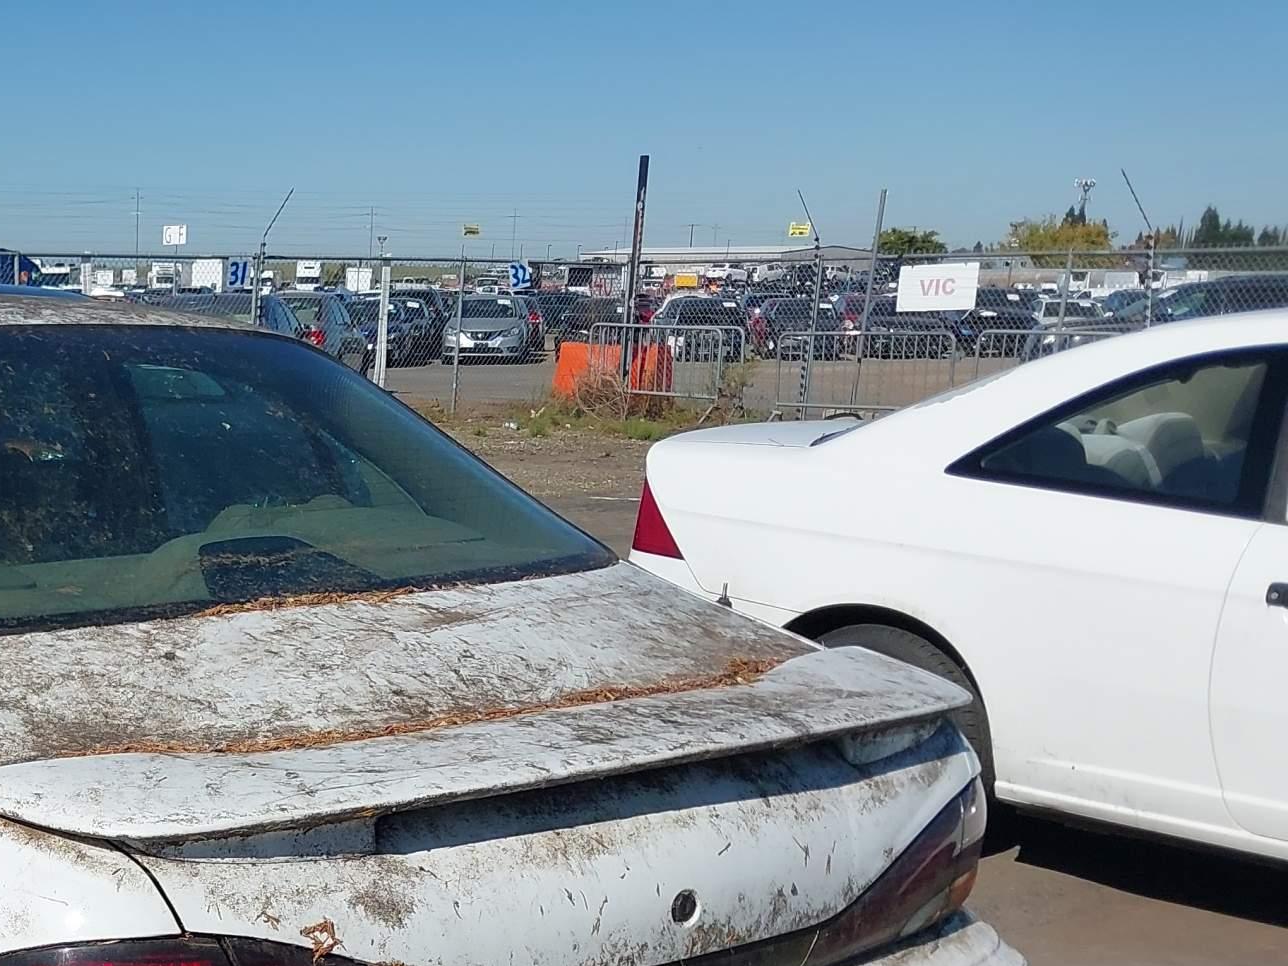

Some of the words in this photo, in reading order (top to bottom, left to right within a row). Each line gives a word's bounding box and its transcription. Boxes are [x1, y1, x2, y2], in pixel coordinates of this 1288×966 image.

[228, 261, 248, 285] 31
[510, 263, 531, 287] 32
[920, 278, 957, 297] VIC
